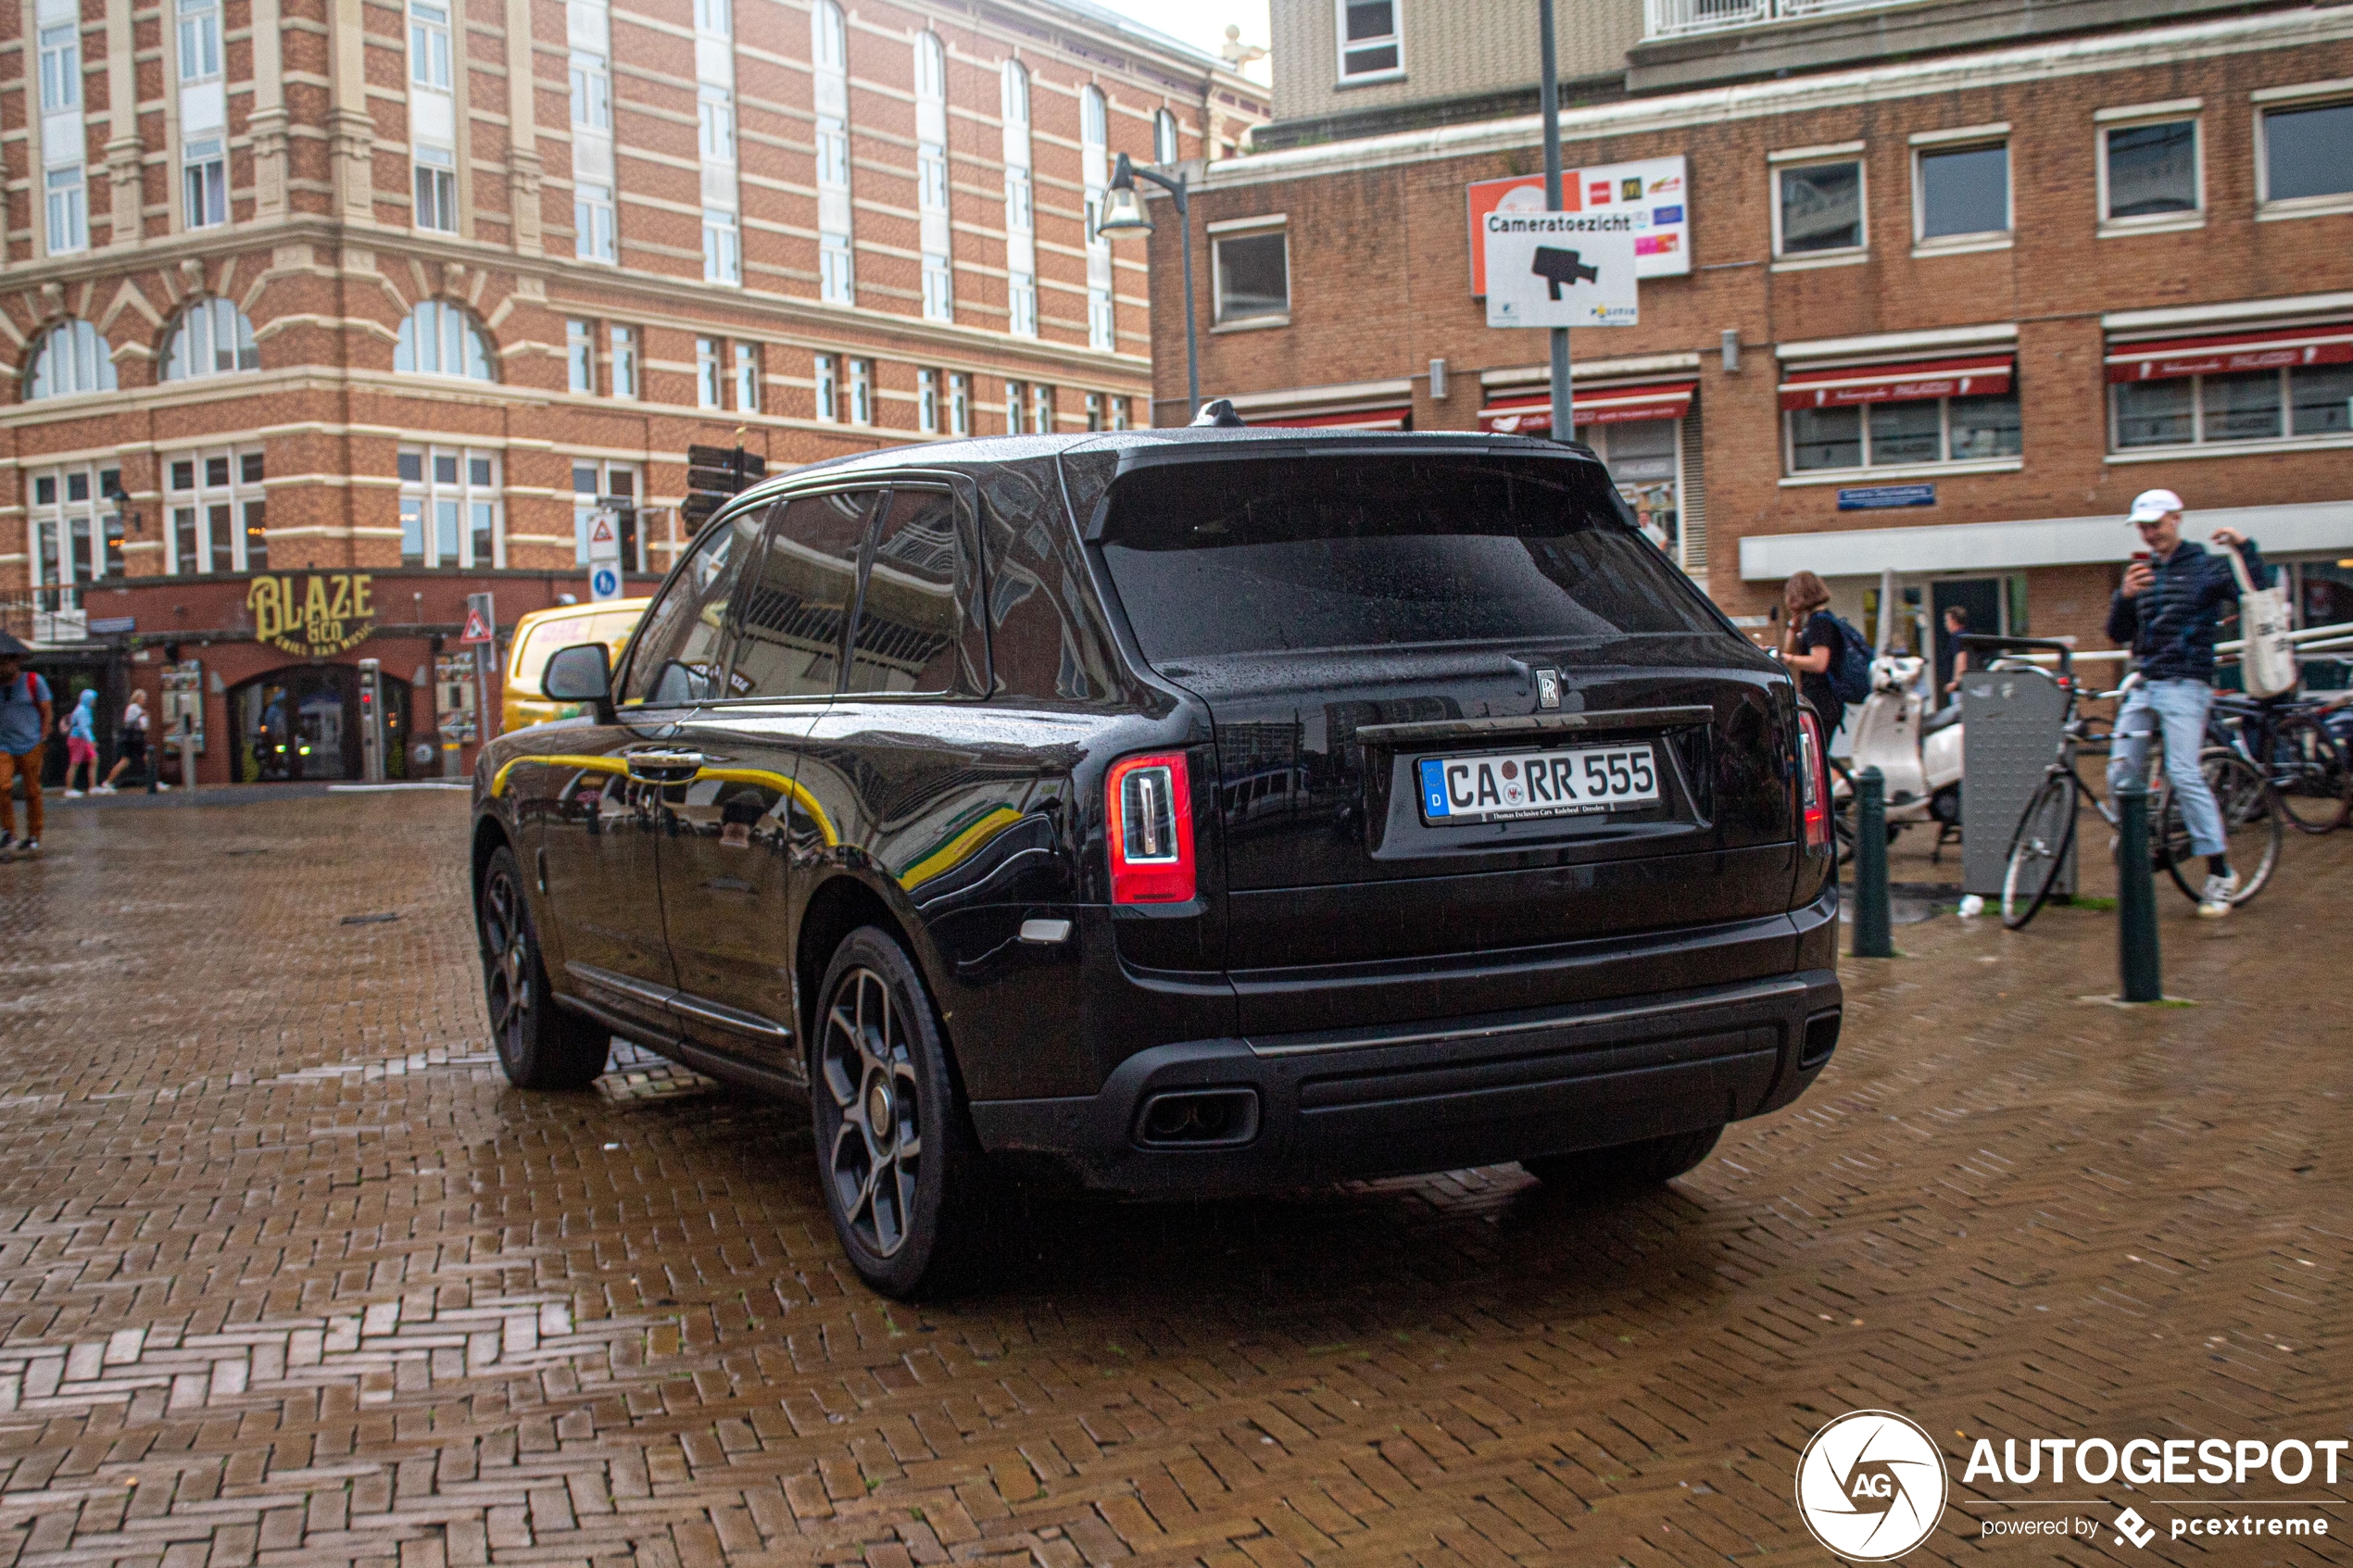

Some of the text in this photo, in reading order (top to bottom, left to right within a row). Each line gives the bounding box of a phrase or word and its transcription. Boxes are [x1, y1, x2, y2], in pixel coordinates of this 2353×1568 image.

[1489, 214, 1630, 232] Cameratoezicht
[246, 574, 375, 643] BLAZE
[1447, 751, 1654, 808] CA RR 555
[1431, 793, 1441, 807] D
[1492, 811, 1515, 820] Thomas
[1515, 809, 1540, 819] Exclusive
[1540, 808, 1553, 816] Cars
[1582, 804, 1604, 813] Dresden
